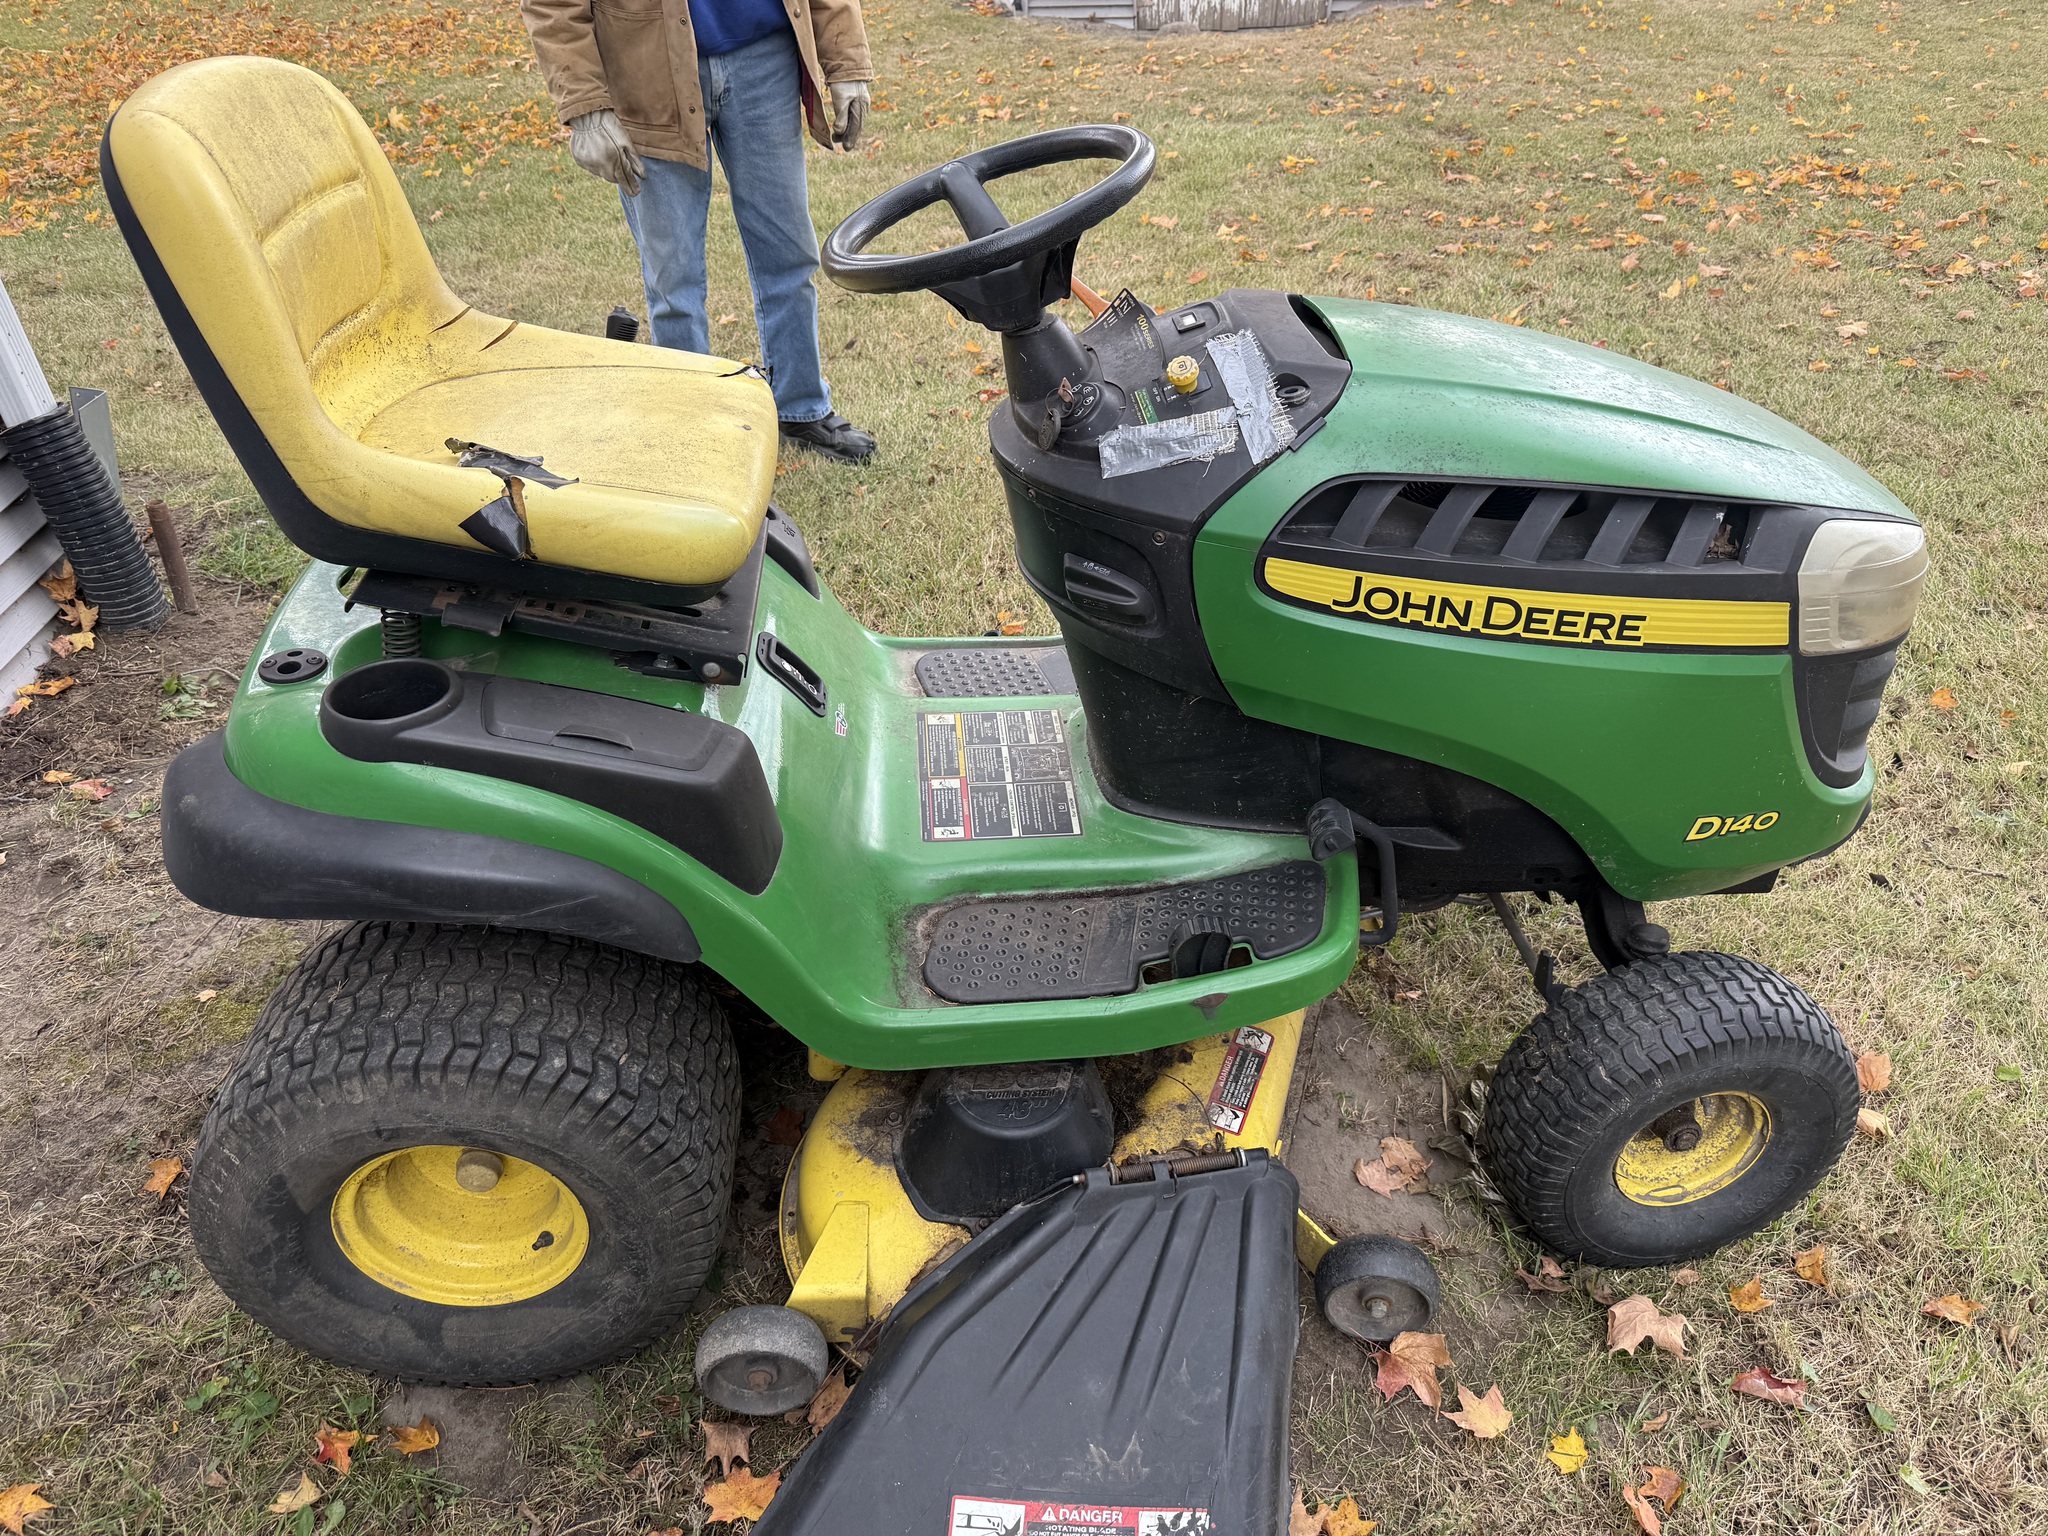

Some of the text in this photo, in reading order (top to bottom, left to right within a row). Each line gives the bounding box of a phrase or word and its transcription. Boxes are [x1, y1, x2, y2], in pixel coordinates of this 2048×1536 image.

[1136, 313, 1149, 331] 100
[1142, 329, 1155, 349] SERIES
[1332, 576, 1647, 642] JOHN DEERE
[1683, 810, 1781, 843] D140
[1219, 1055, 1234, 1082] DANGER
[986, 1089, 1056, 1099] CUTTING SYSTEM
[1059, 1508, 1122, 1523] DANGER
